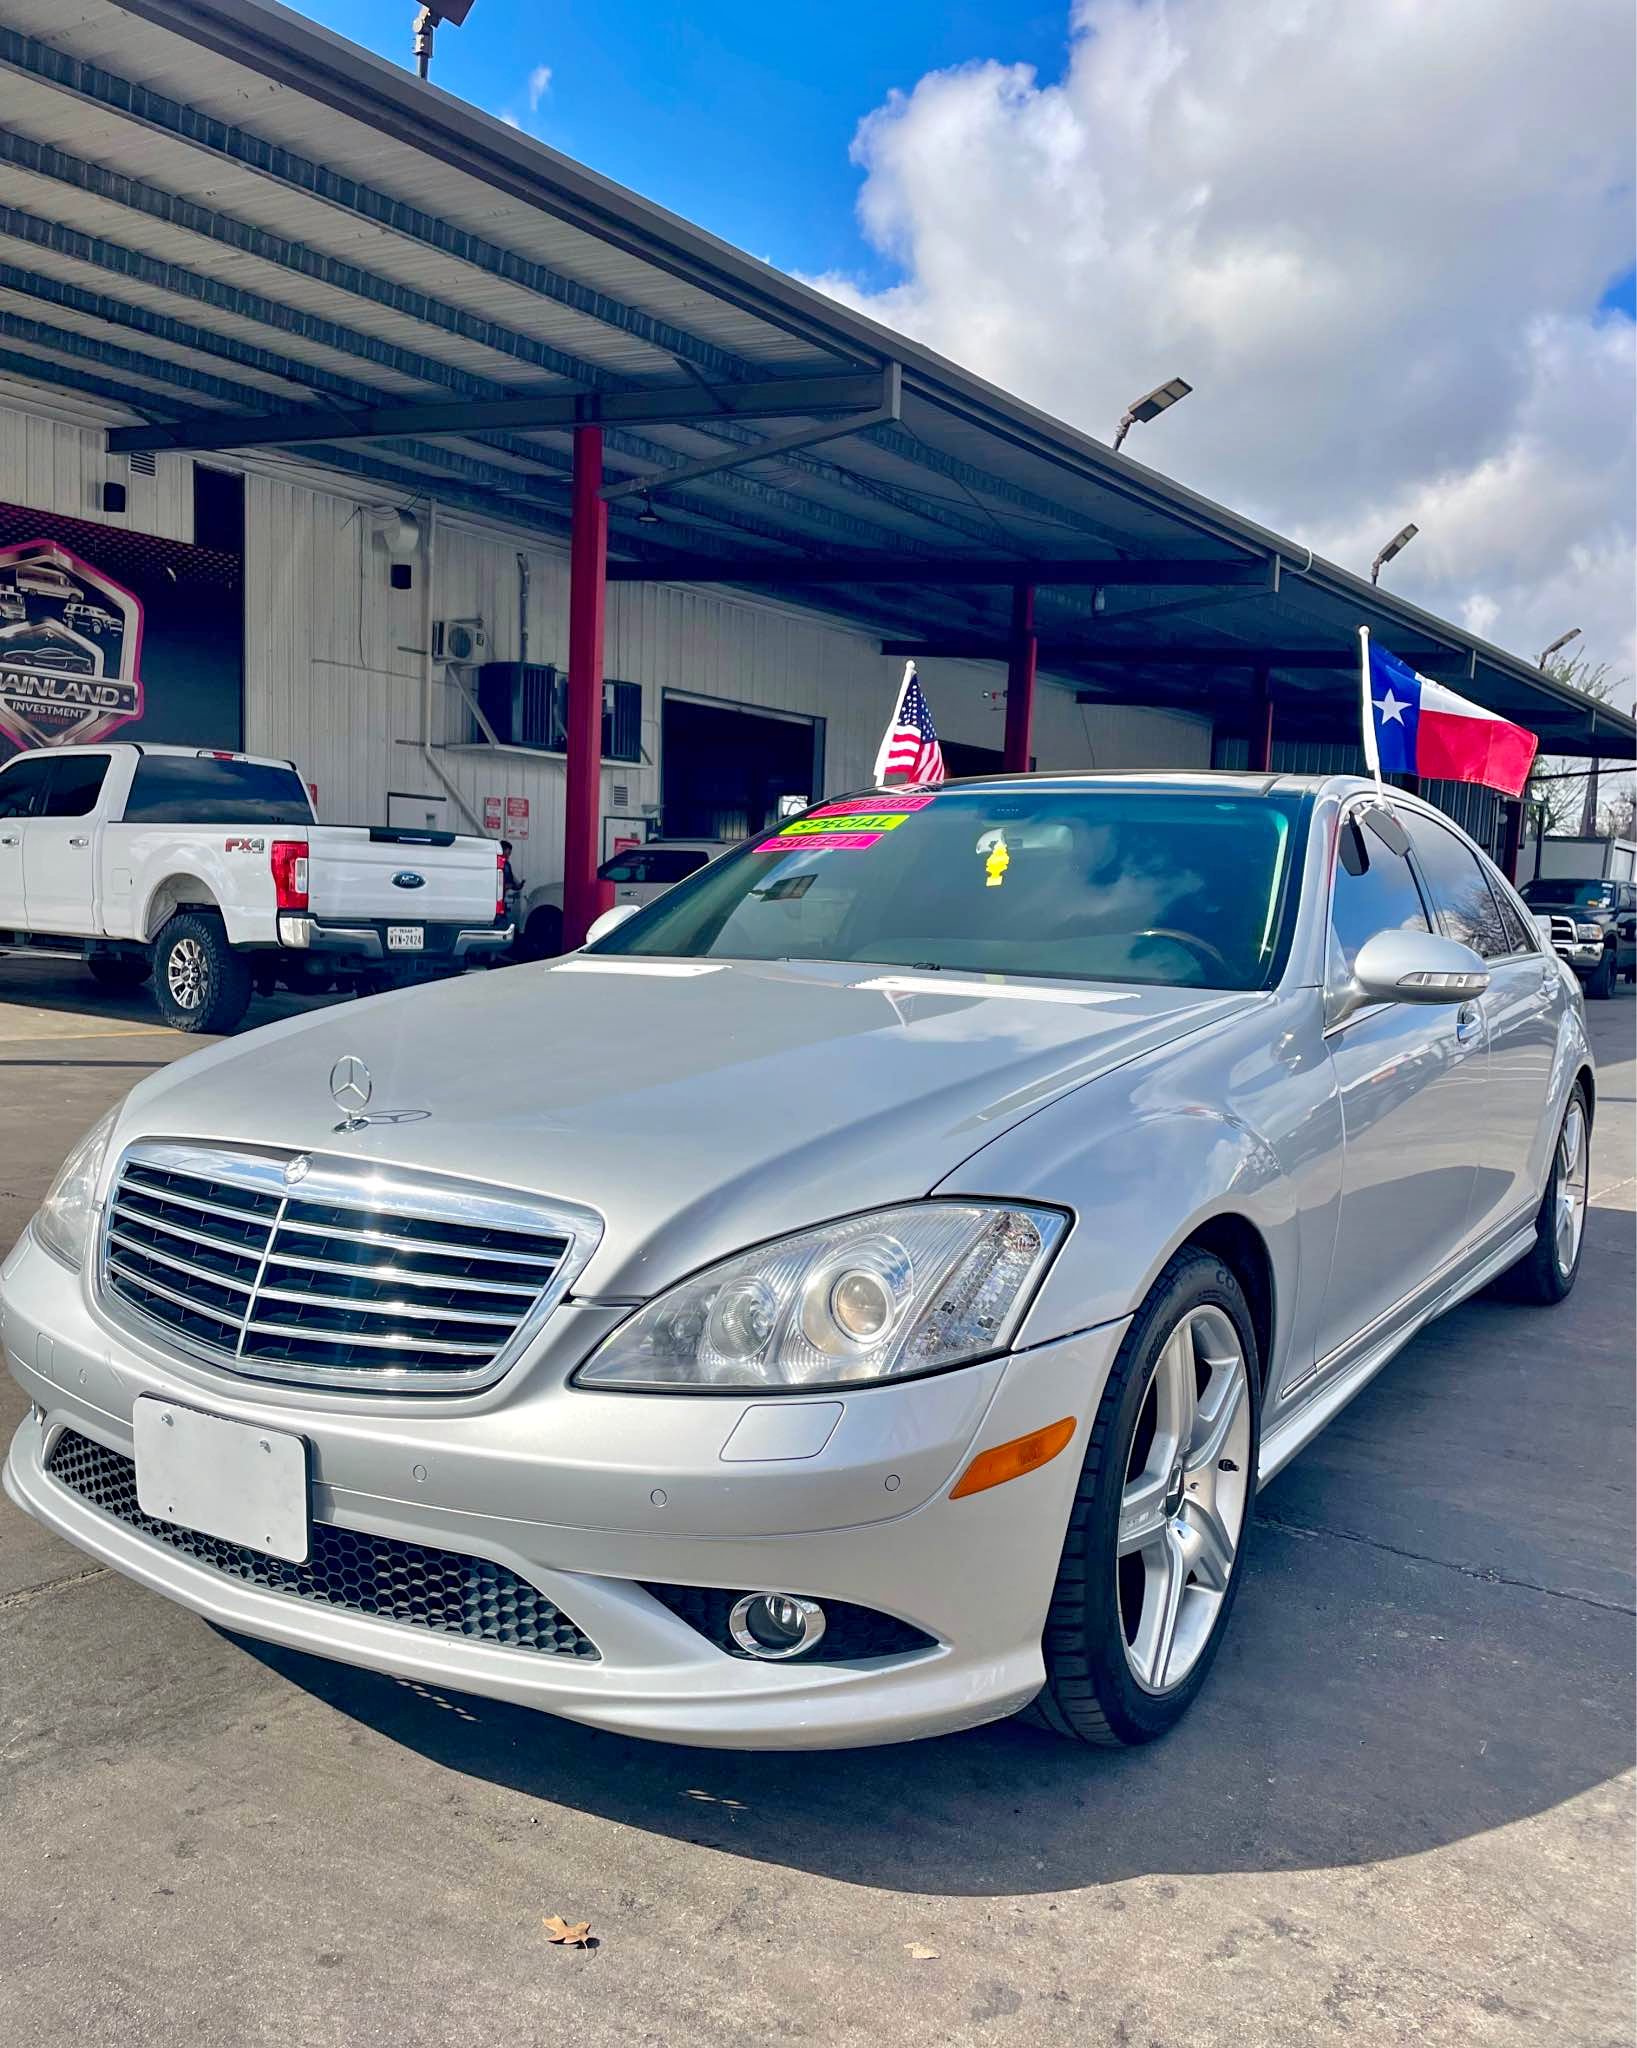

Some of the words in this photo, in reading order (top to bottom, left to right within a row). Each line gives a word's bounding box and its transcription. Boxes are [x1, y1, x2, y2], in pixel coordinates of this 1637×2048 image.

[0, 672, 119, 706] AINLAND
[12, 701, 86, 718] INVESTMENT
[793, 817, 890, 831] SPECIAL
[225, 838, 264, 852] FX4
